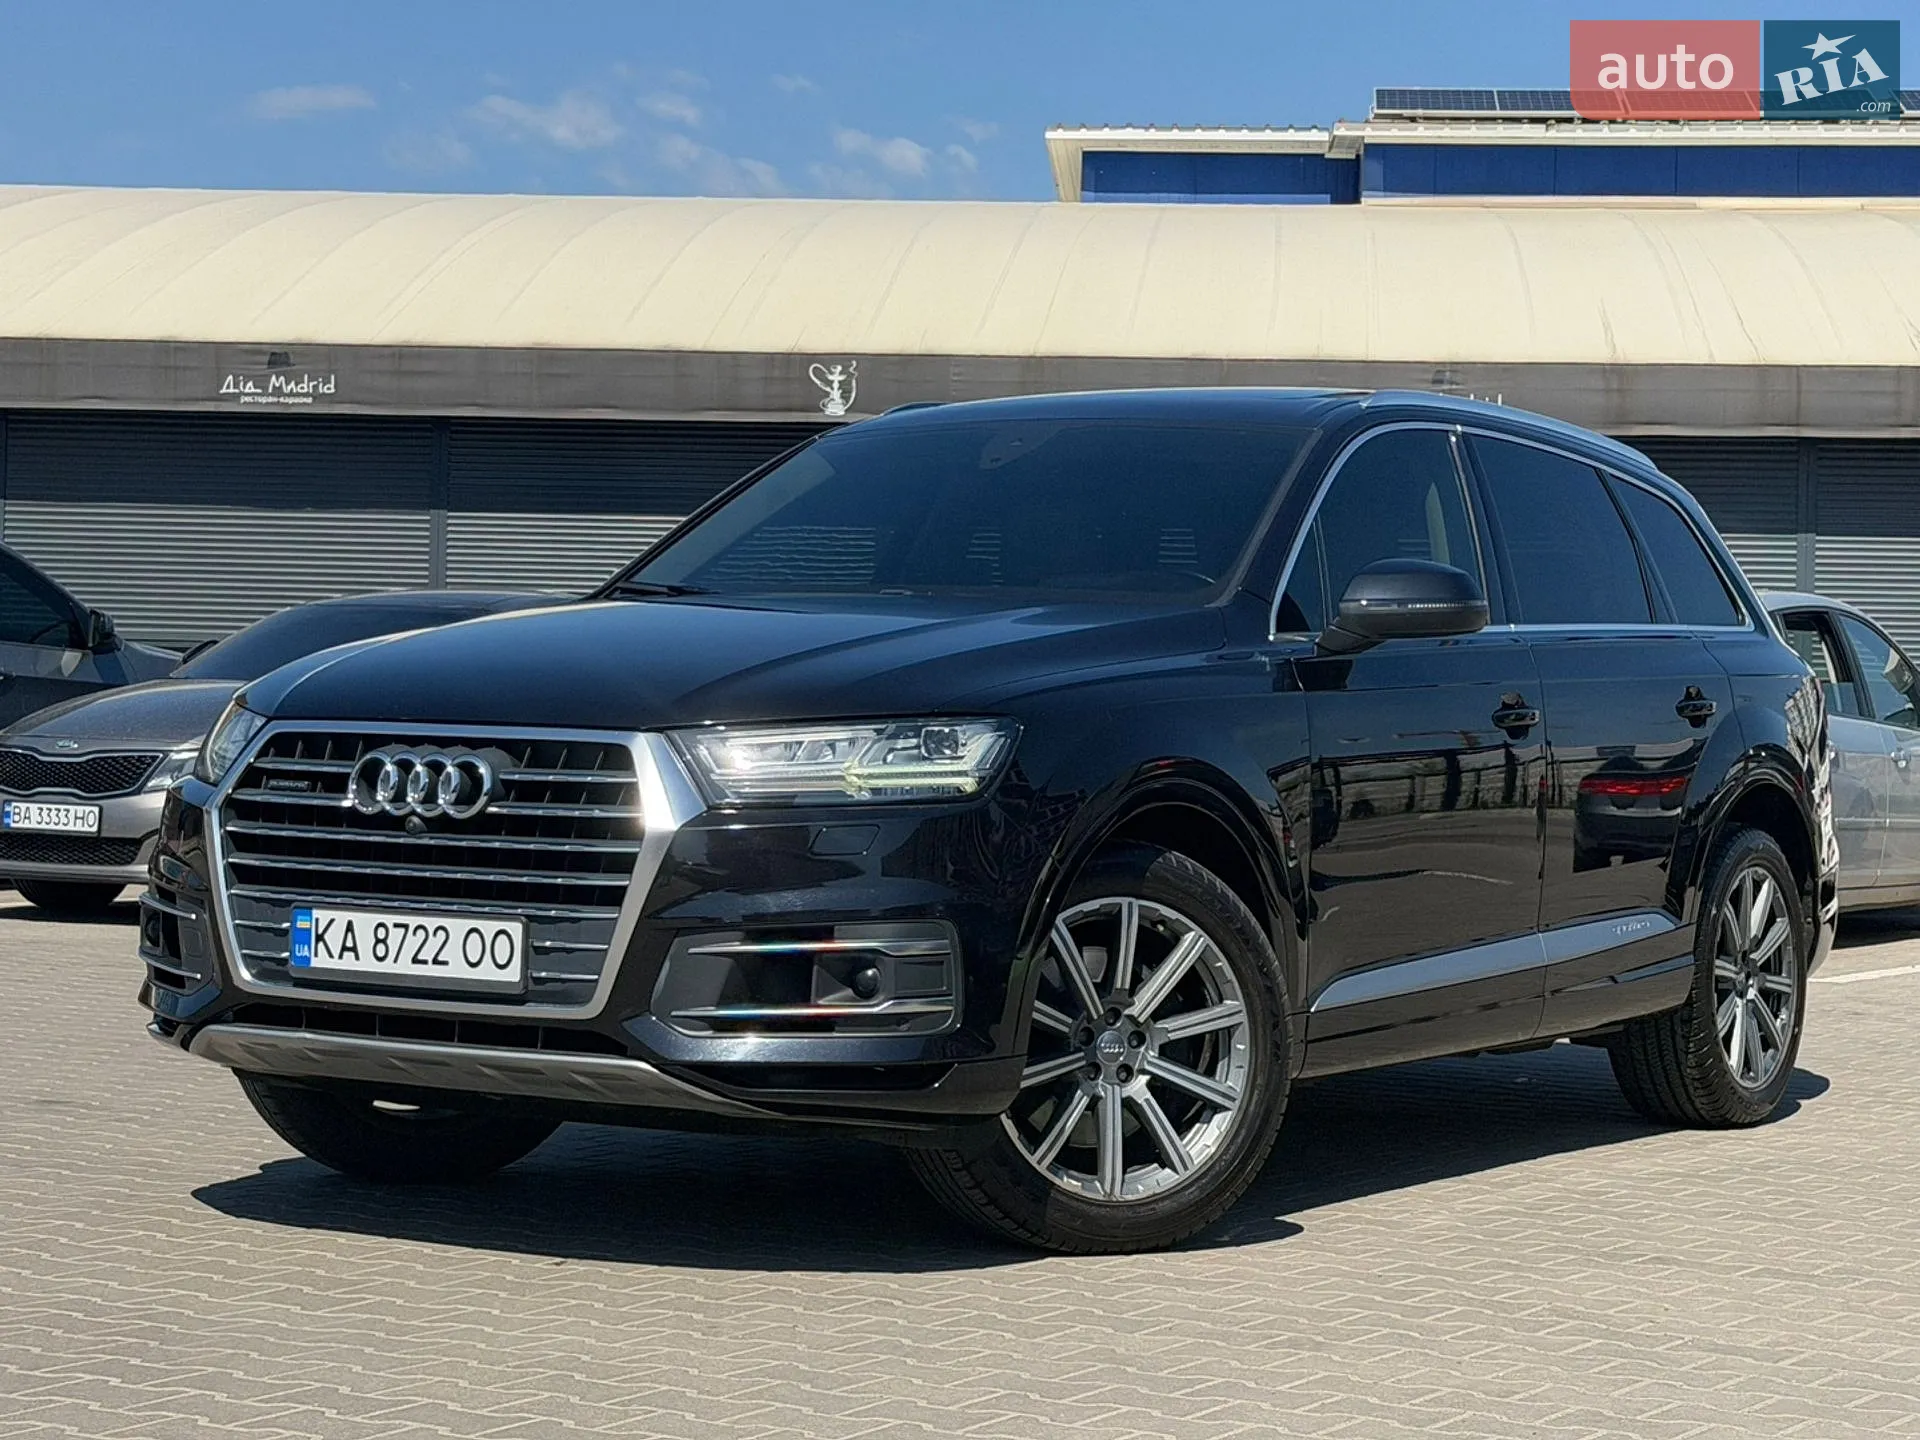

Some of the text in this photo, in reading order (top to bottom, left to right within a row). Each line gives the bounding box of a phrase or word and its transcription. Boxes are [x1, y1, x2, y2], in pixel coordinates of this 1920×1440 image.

[268, 373, 336, 393] Madrid
[12, 805, 97, 829] BA 3333 HO
[295, 944, 310, 958] UA
[313, 917, 515, 970] KA 8722 OO
